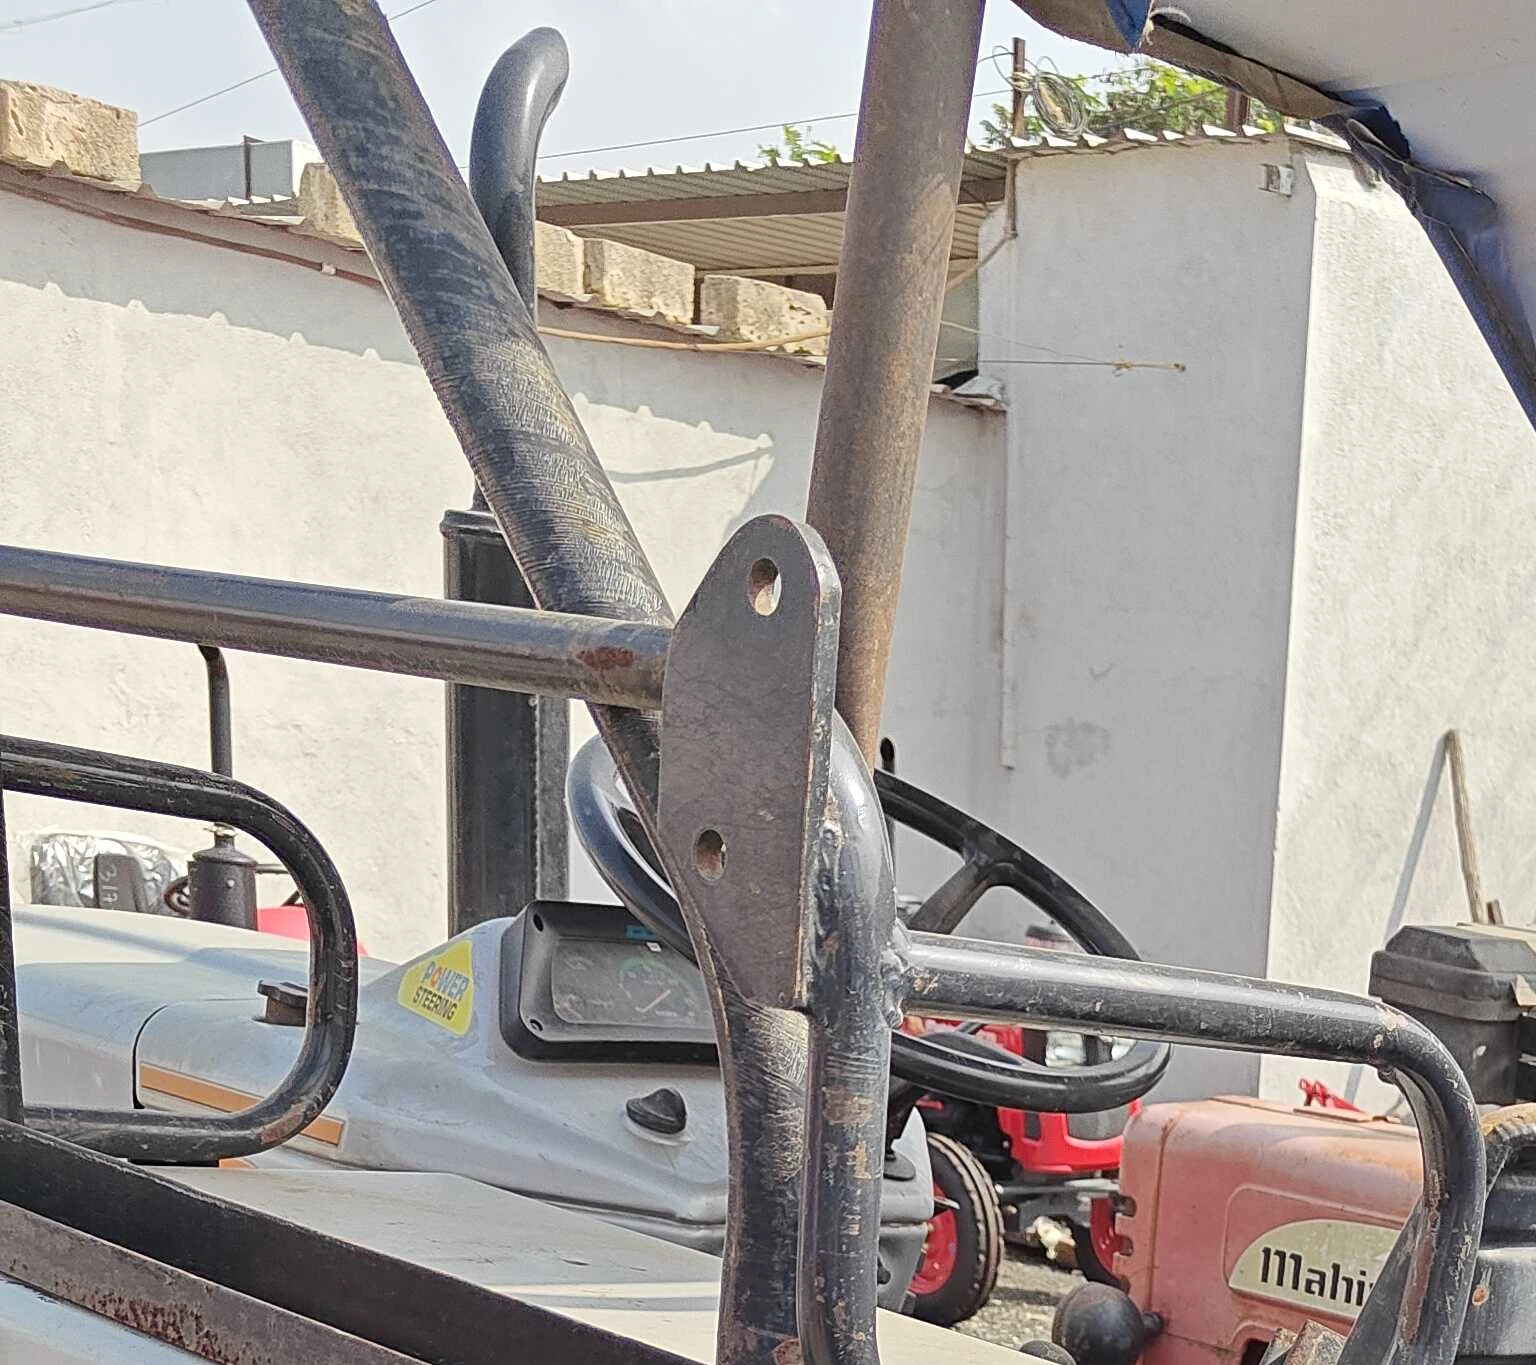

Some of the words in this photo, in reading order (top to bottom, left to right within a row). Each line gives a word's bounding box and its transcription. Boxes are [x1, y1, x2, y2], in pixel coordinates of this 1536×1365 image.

[421, 961, 470, 1001] POWER
[413, 986, 458, 1020] STEERING
[1261, 1246, 1374, 1307] Mahi
